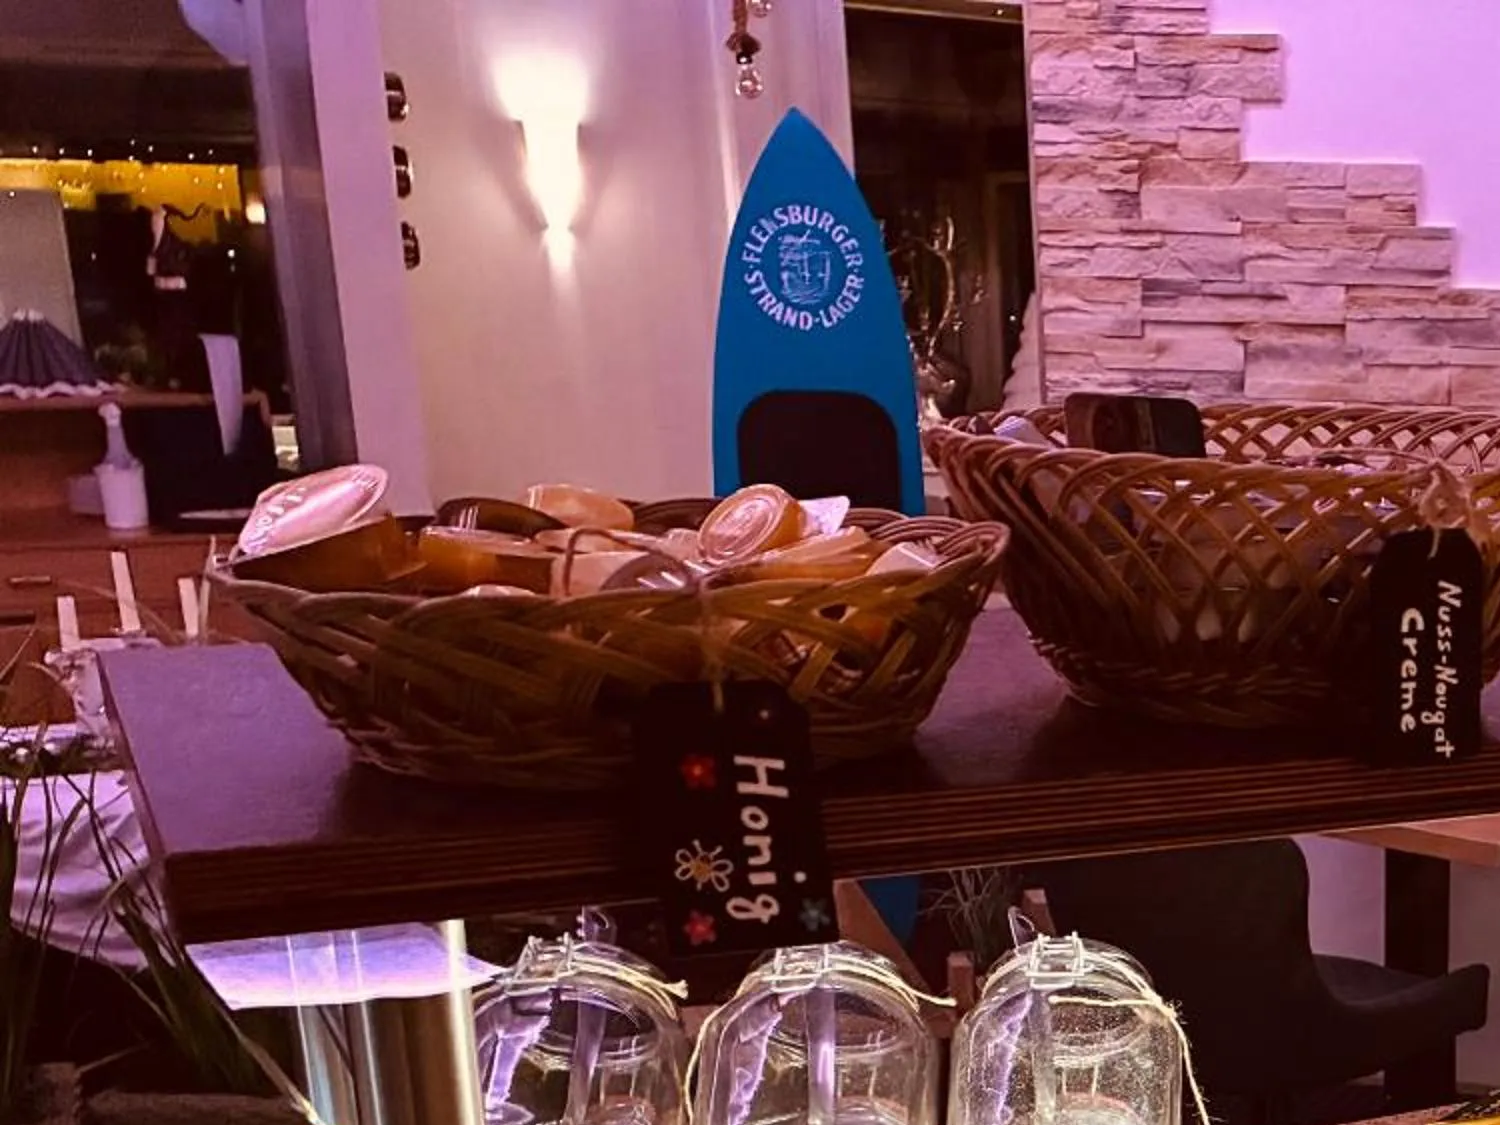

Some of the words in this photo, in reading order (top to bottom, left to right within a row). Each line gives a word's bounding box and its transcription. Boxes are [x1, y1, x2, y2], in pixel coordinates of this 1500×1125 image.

[742, 205, 863, 267] FLENSBURGER
[1401, 607, 1426, 733] Creme
[1421, 580, 1463, 758] Nuss-Nougat
[726, 755, 806, 924] Honig
